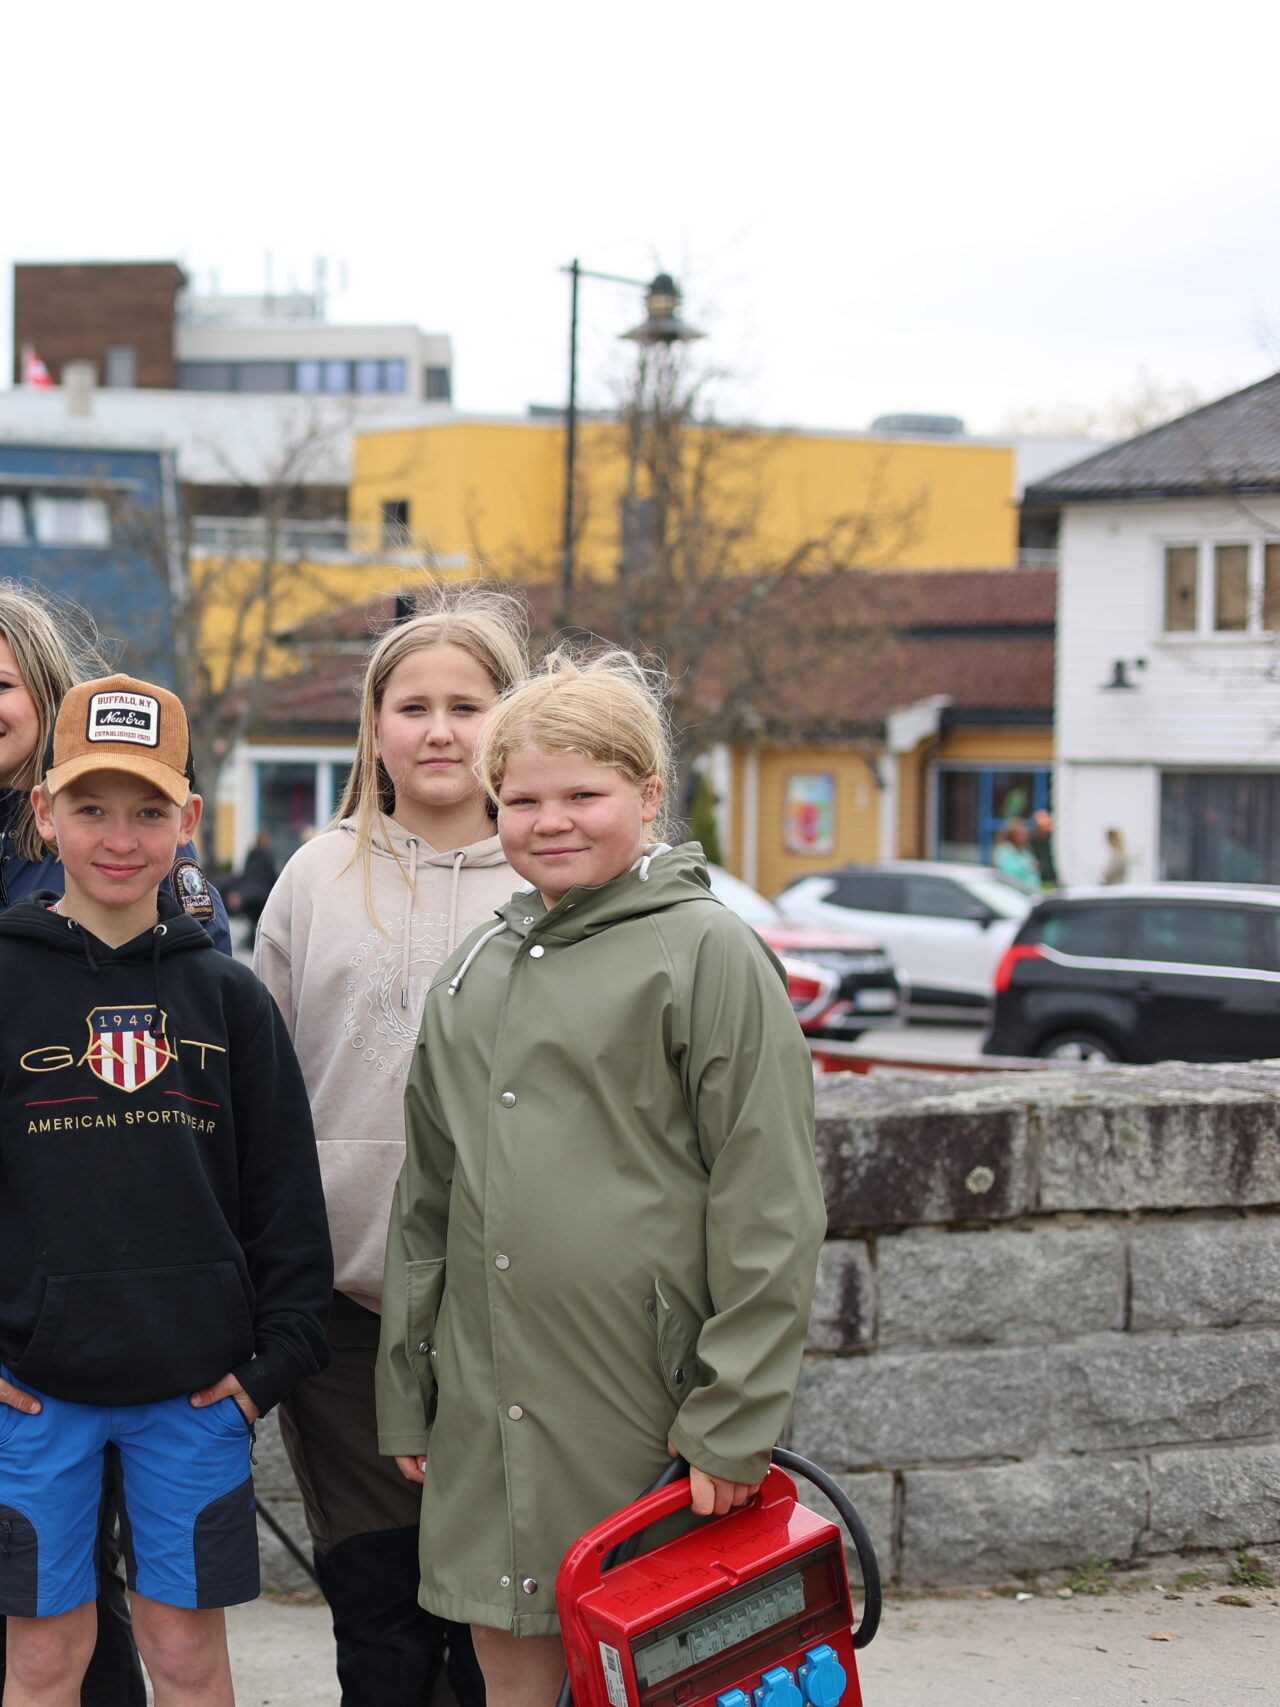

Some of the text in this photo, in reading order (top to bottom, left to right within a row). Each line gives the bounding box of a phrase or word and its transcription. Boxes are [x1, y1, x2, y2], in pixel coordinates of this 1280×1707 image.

[97, 695, 137, 706] BUFFALO,
[100, 711, 145, 726] New Era
[94, 730, 136, 739] ESTABLISHED
[99, 1014, 153, 1028] 1949
[20, 1036, 226, 1072] GANT
[27, 1114, 117, 1134] AMERICAN
